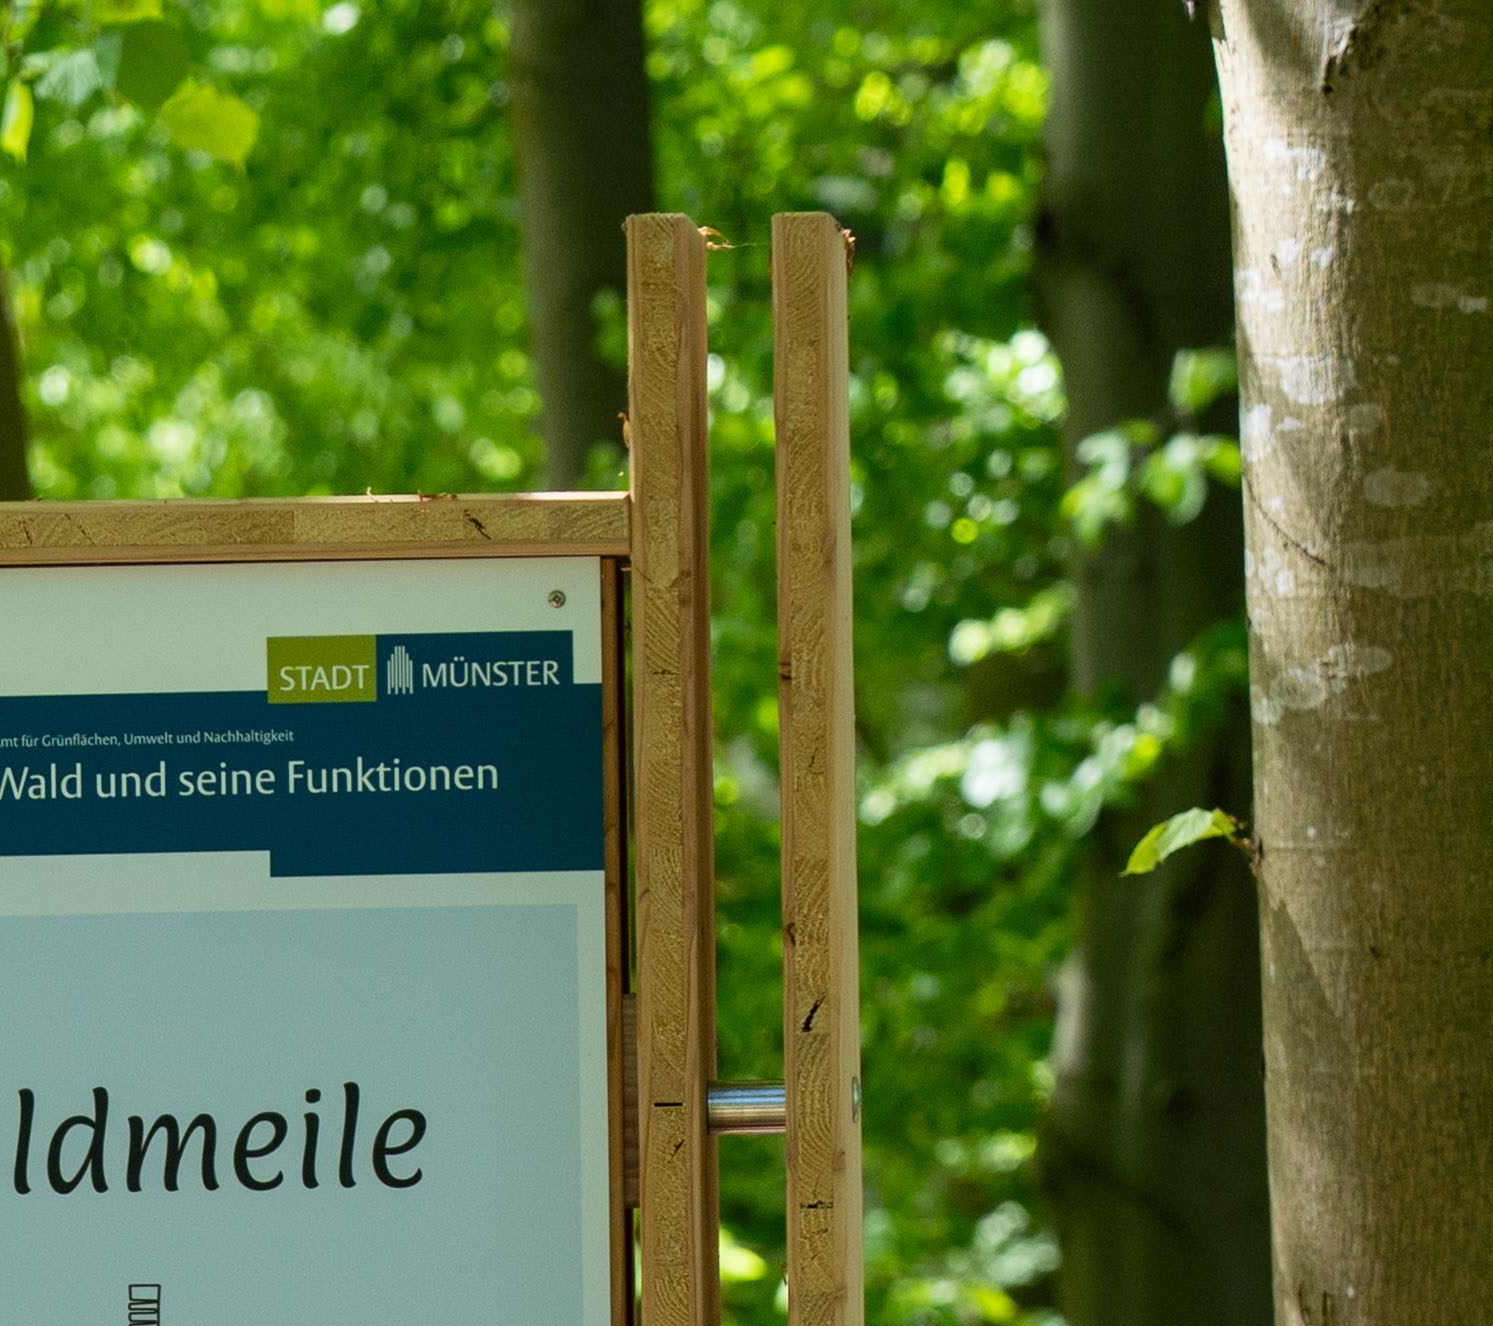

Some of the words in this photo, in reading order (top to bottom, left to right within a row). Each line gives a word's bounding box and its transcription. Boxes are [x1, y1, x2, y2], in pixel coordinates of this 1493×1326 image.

[279, 664, 370, 691] STADT
[422, 656, 560, 688] MÜNSTER
[21, 734, 40, 747] für
[41, 732, 122, 748] Grünflächen,
[124, 730, 173, 746] Umwelt
[176, 730, 202, 745] und
[204, 728, 295, 746] Nachhaltigkeit
[96, 760, 167, 798] und
[178, 761, 276, 797] seine
[287, 756, 498, 794] Funktionen
